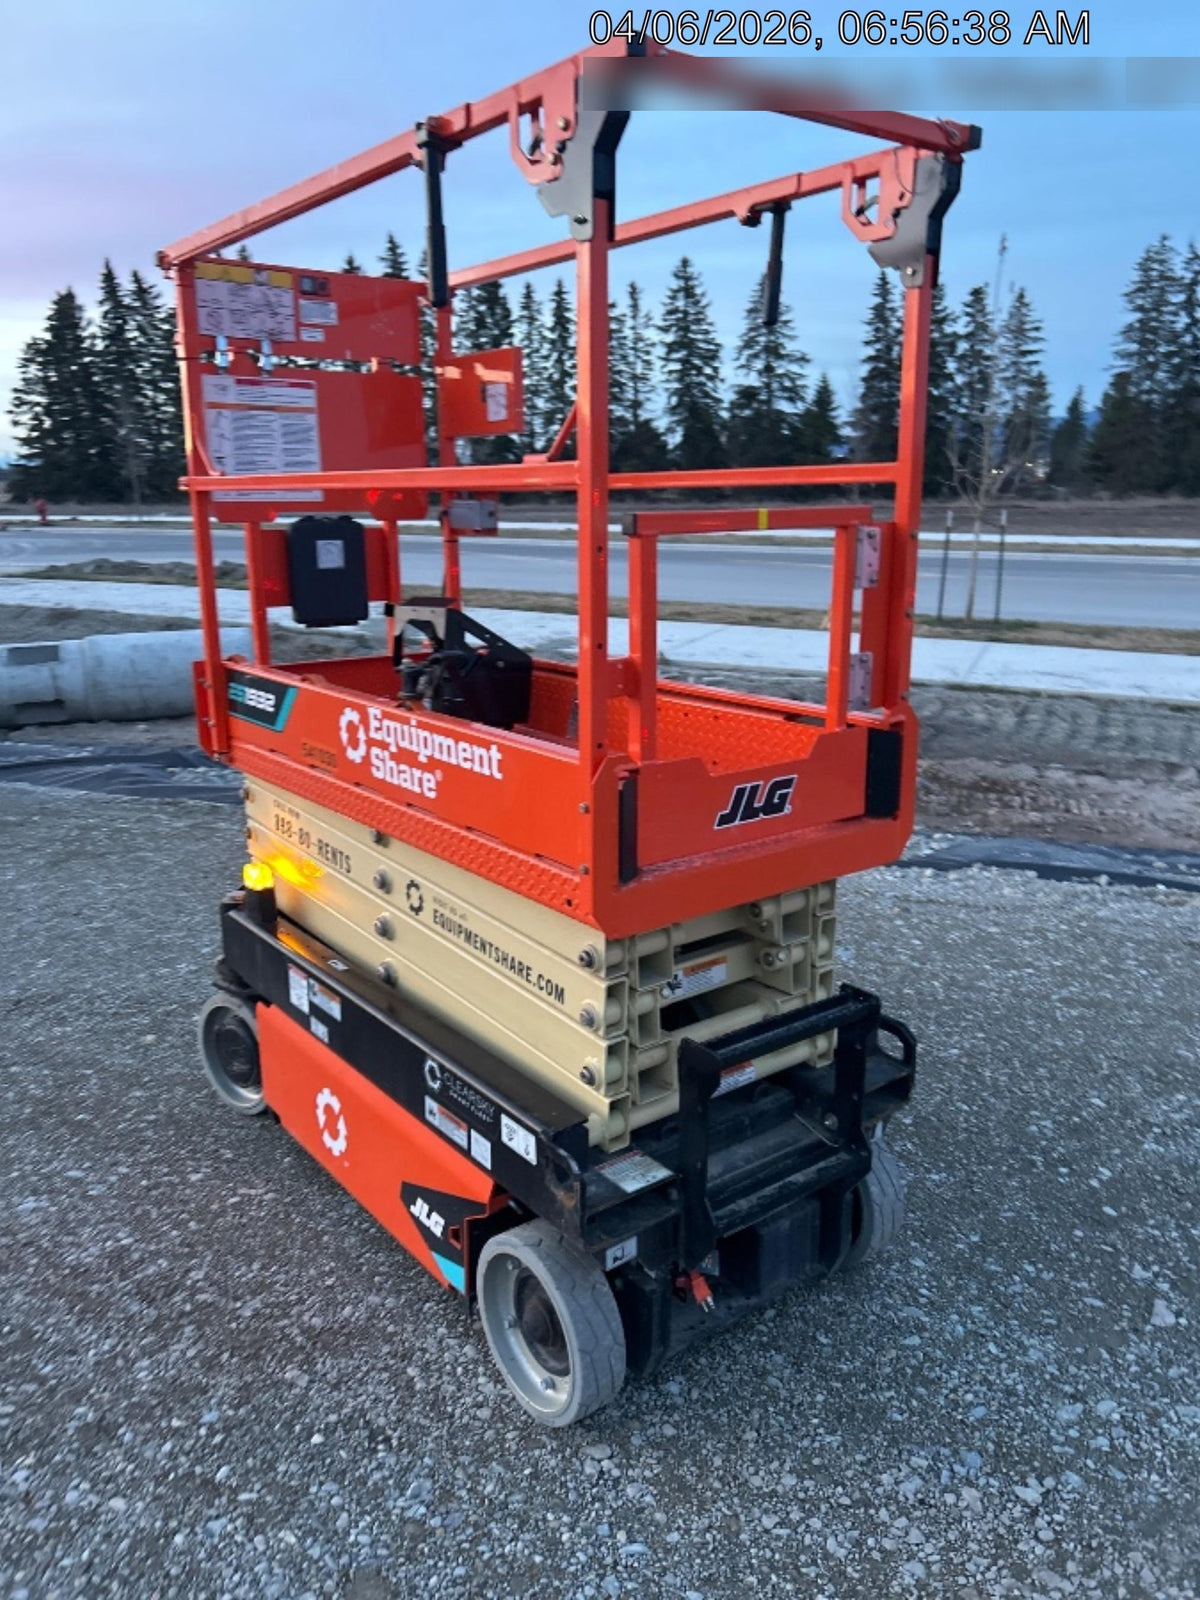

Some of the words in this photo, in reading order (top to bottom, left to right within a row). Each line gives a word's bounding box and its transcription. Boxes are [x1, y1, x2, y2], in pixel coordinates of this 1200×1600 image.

[367, 706, 503, 779] Equipment
[714, 774, 798, 830] JLG
[432, 908, 565, 1005] EQUIPMENTSHARE.COM
[410, 1196, 445, 1238] JLG
